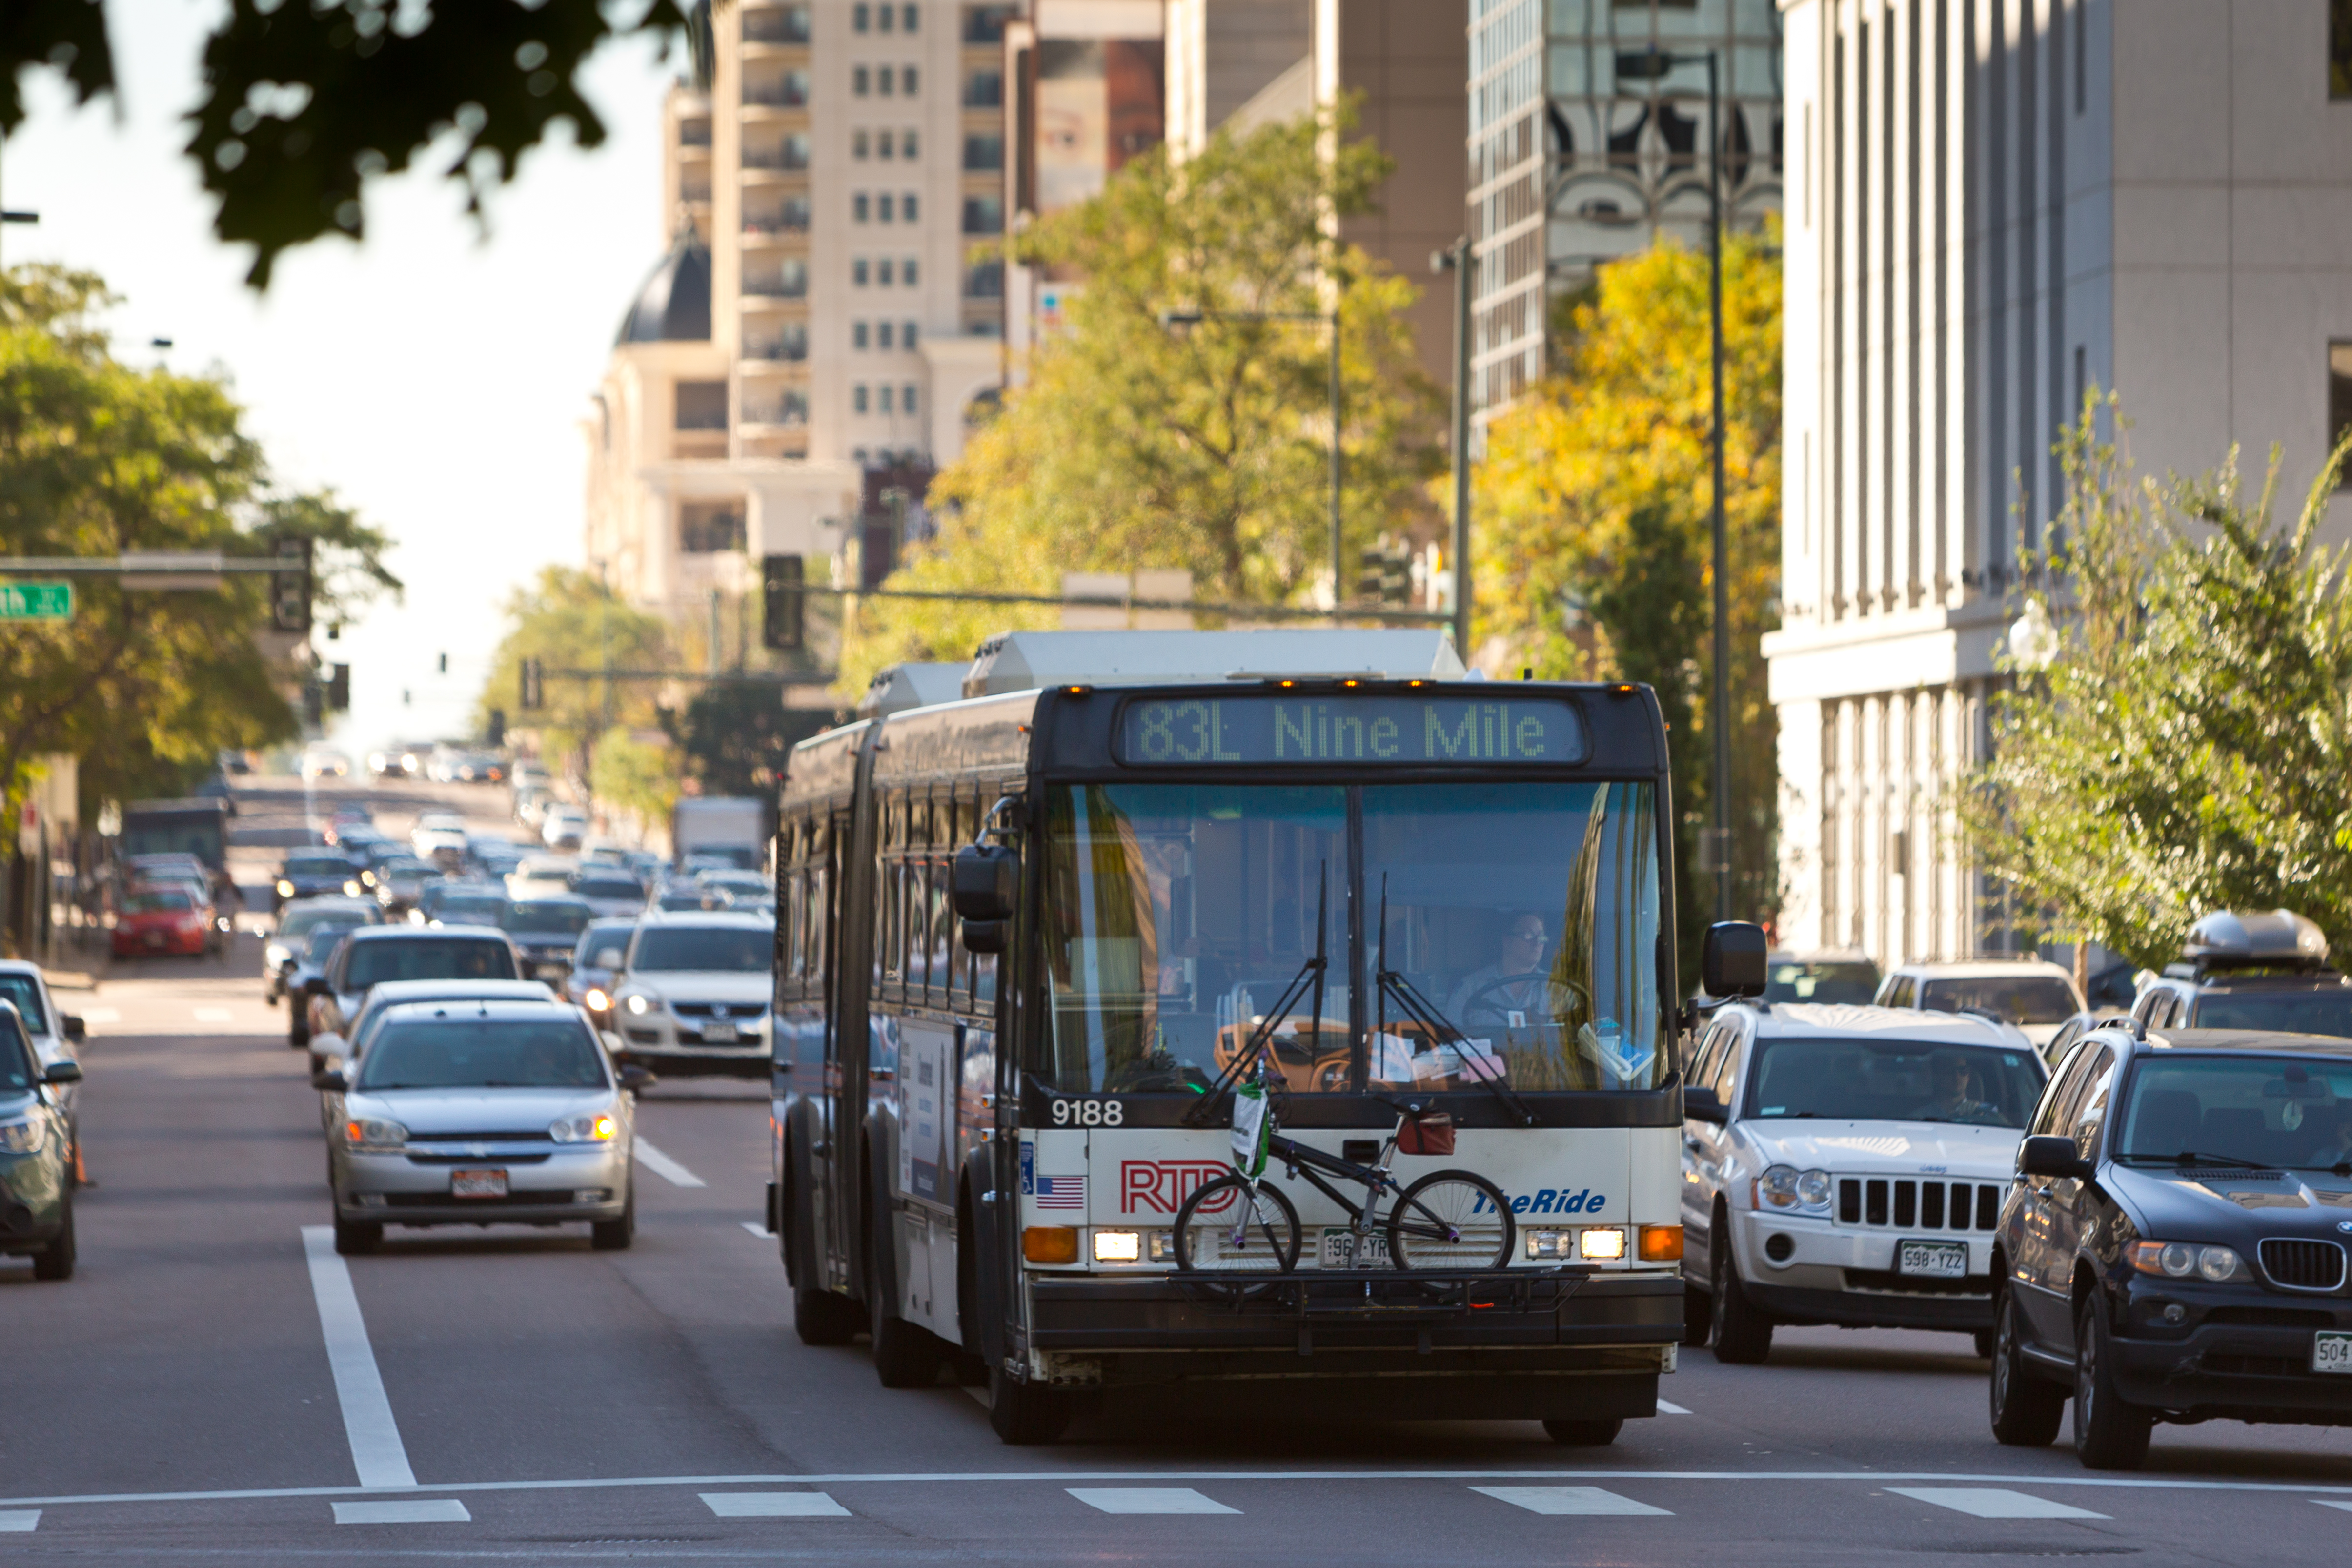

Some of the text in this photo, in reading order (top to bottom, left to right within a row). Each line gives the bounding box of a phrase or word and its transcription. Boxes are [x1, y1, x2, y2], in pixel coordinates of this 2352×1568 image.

[1140, 701, 1544, 761] 83L Nine Mile
[1052, 1099, 1123, 1126] 9188
[1121, 1160, 1238, 1213] RTD
